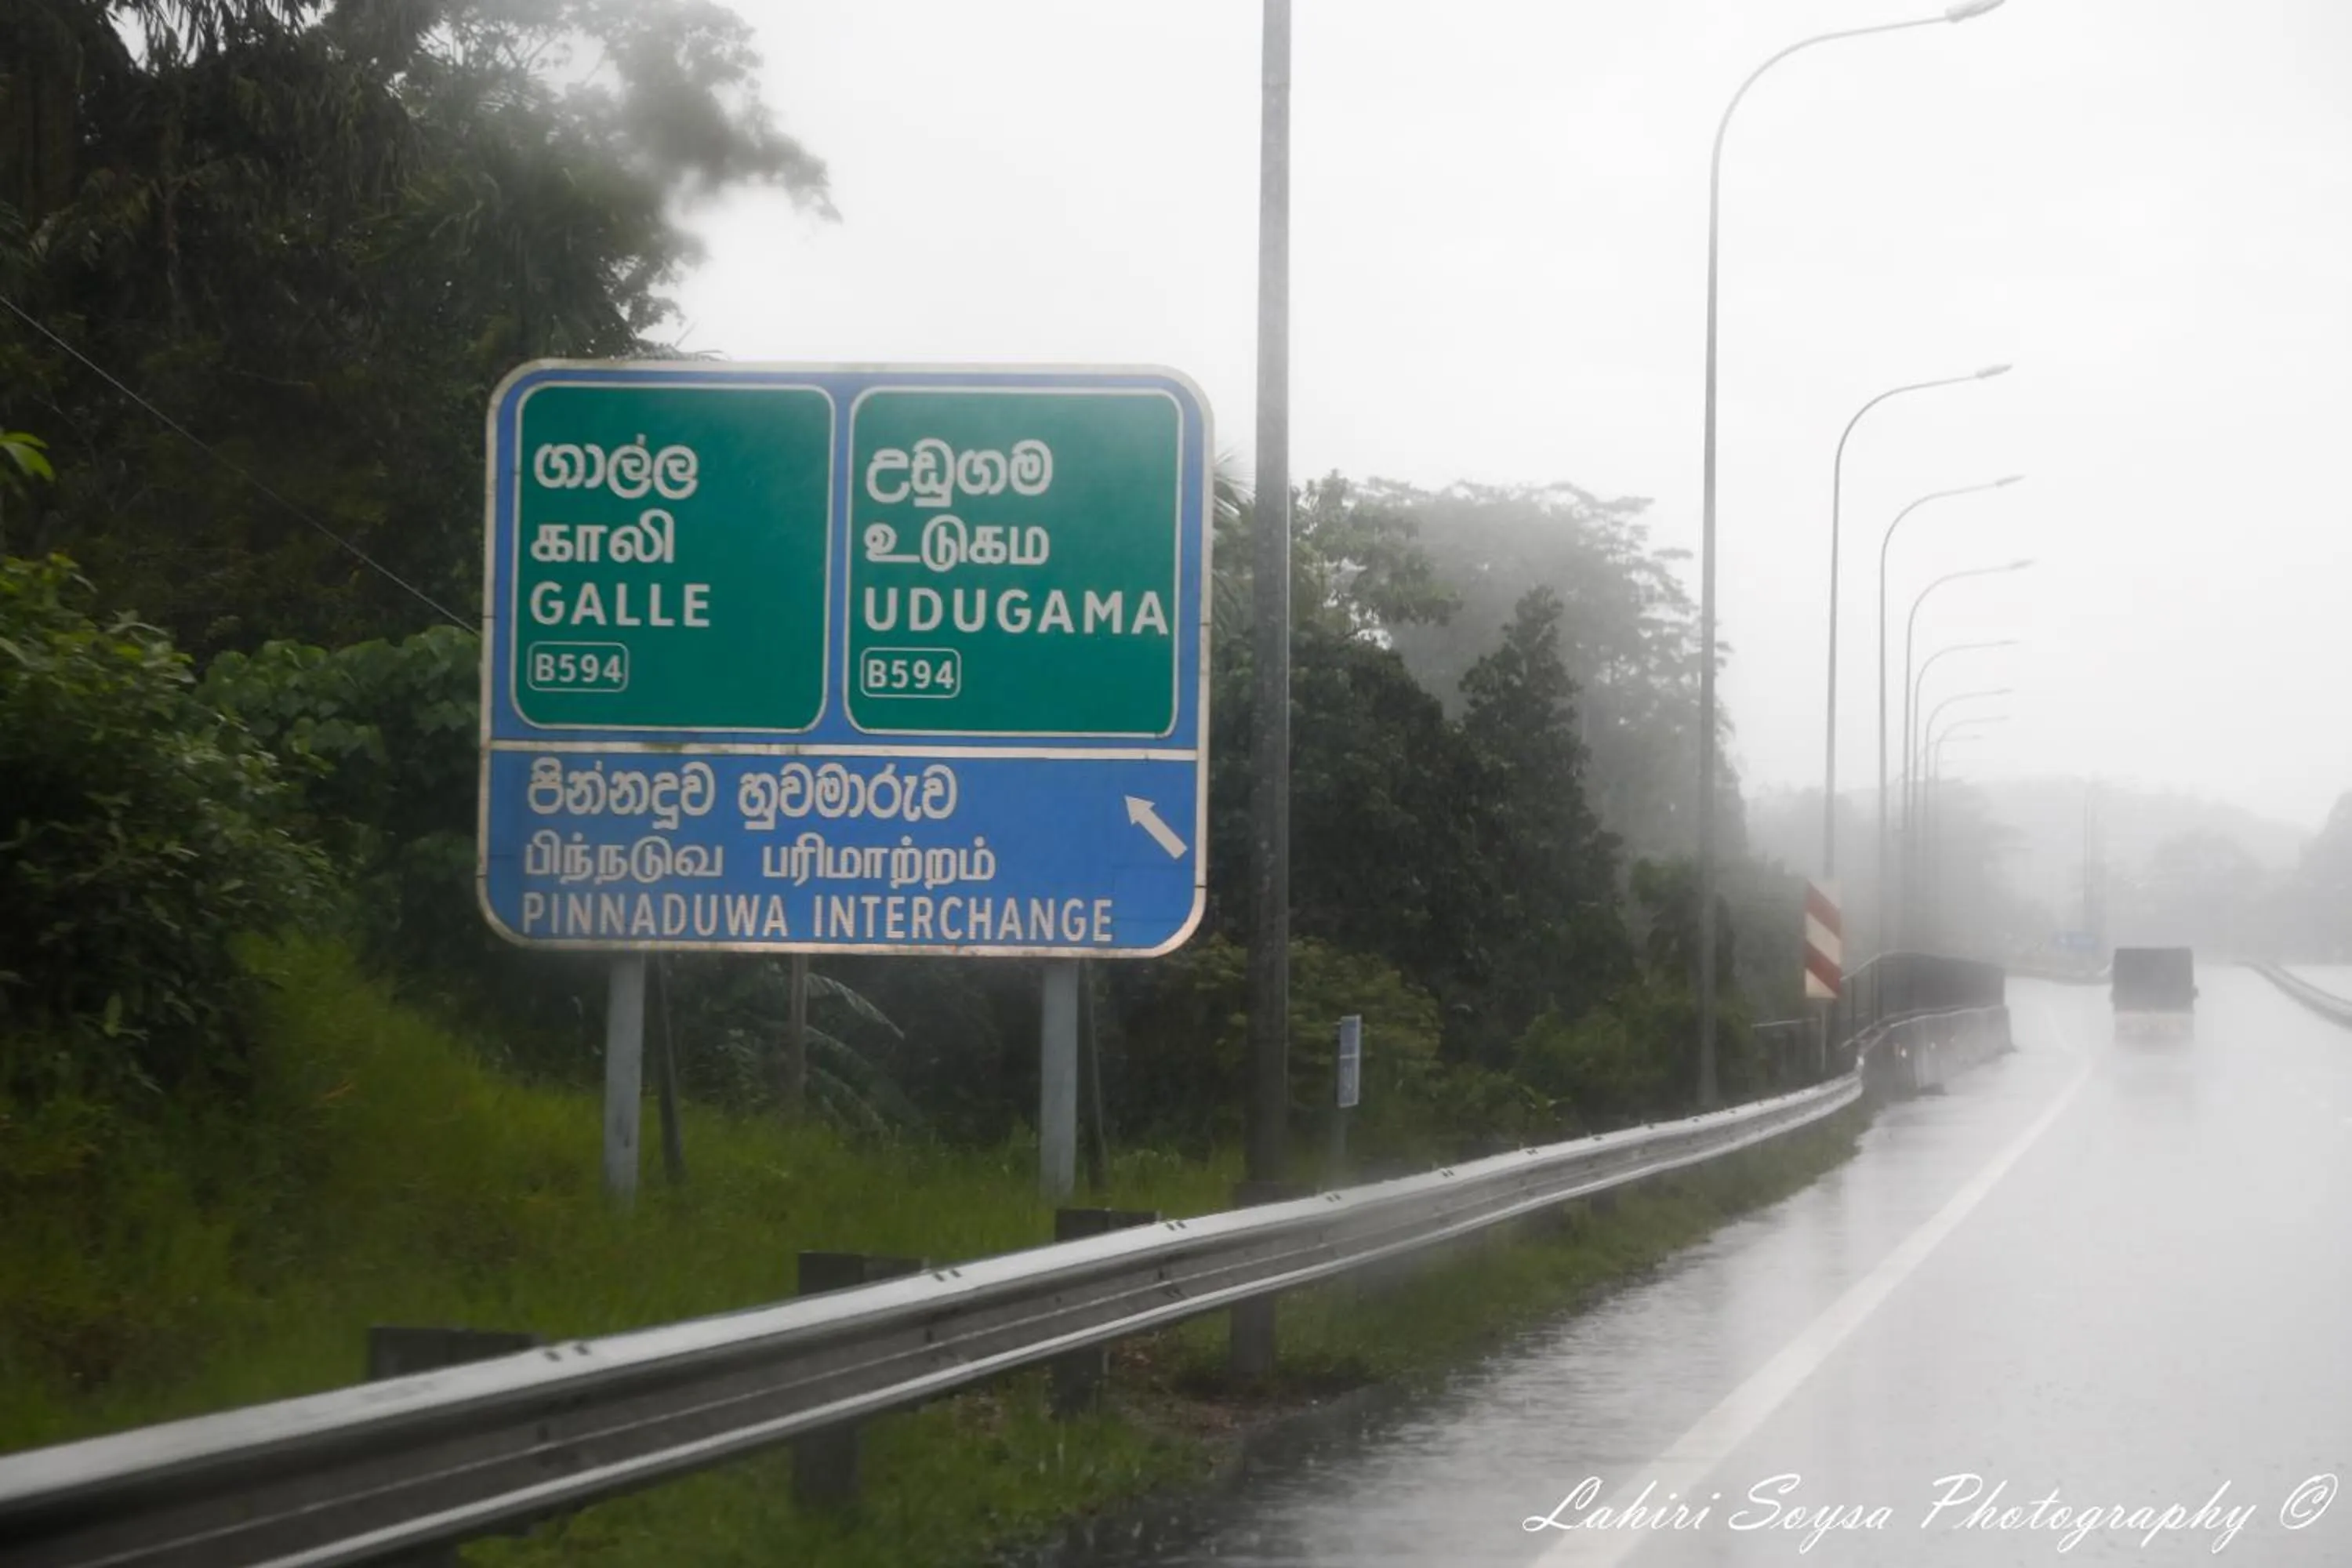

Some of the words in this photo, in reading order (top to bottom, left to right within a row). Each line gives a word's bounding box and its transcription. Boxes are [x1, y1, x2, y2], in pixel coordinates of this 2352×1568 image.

[534, 434, 699, 499] ගාල්ල
[866, 437, 1053, 507] උඩුගම
[530, 508, 675, 563] காலி
[864, 514, 1050, 572] உடுகம
[530, 581, 710, 626] GALLE
[865, 587, 1169, 634] UDUGAMA
[535, 653, 623, 683] B594
[867, 660, 955, 689] B594
[738, 761, 957, 830] හුවමාරුව
[762, 832, 996, 889] பரிமாற்றம்
[522, 892, 789, 936] PINNADUWA
[814, 895, 1113, 942] INTERCHANGE
